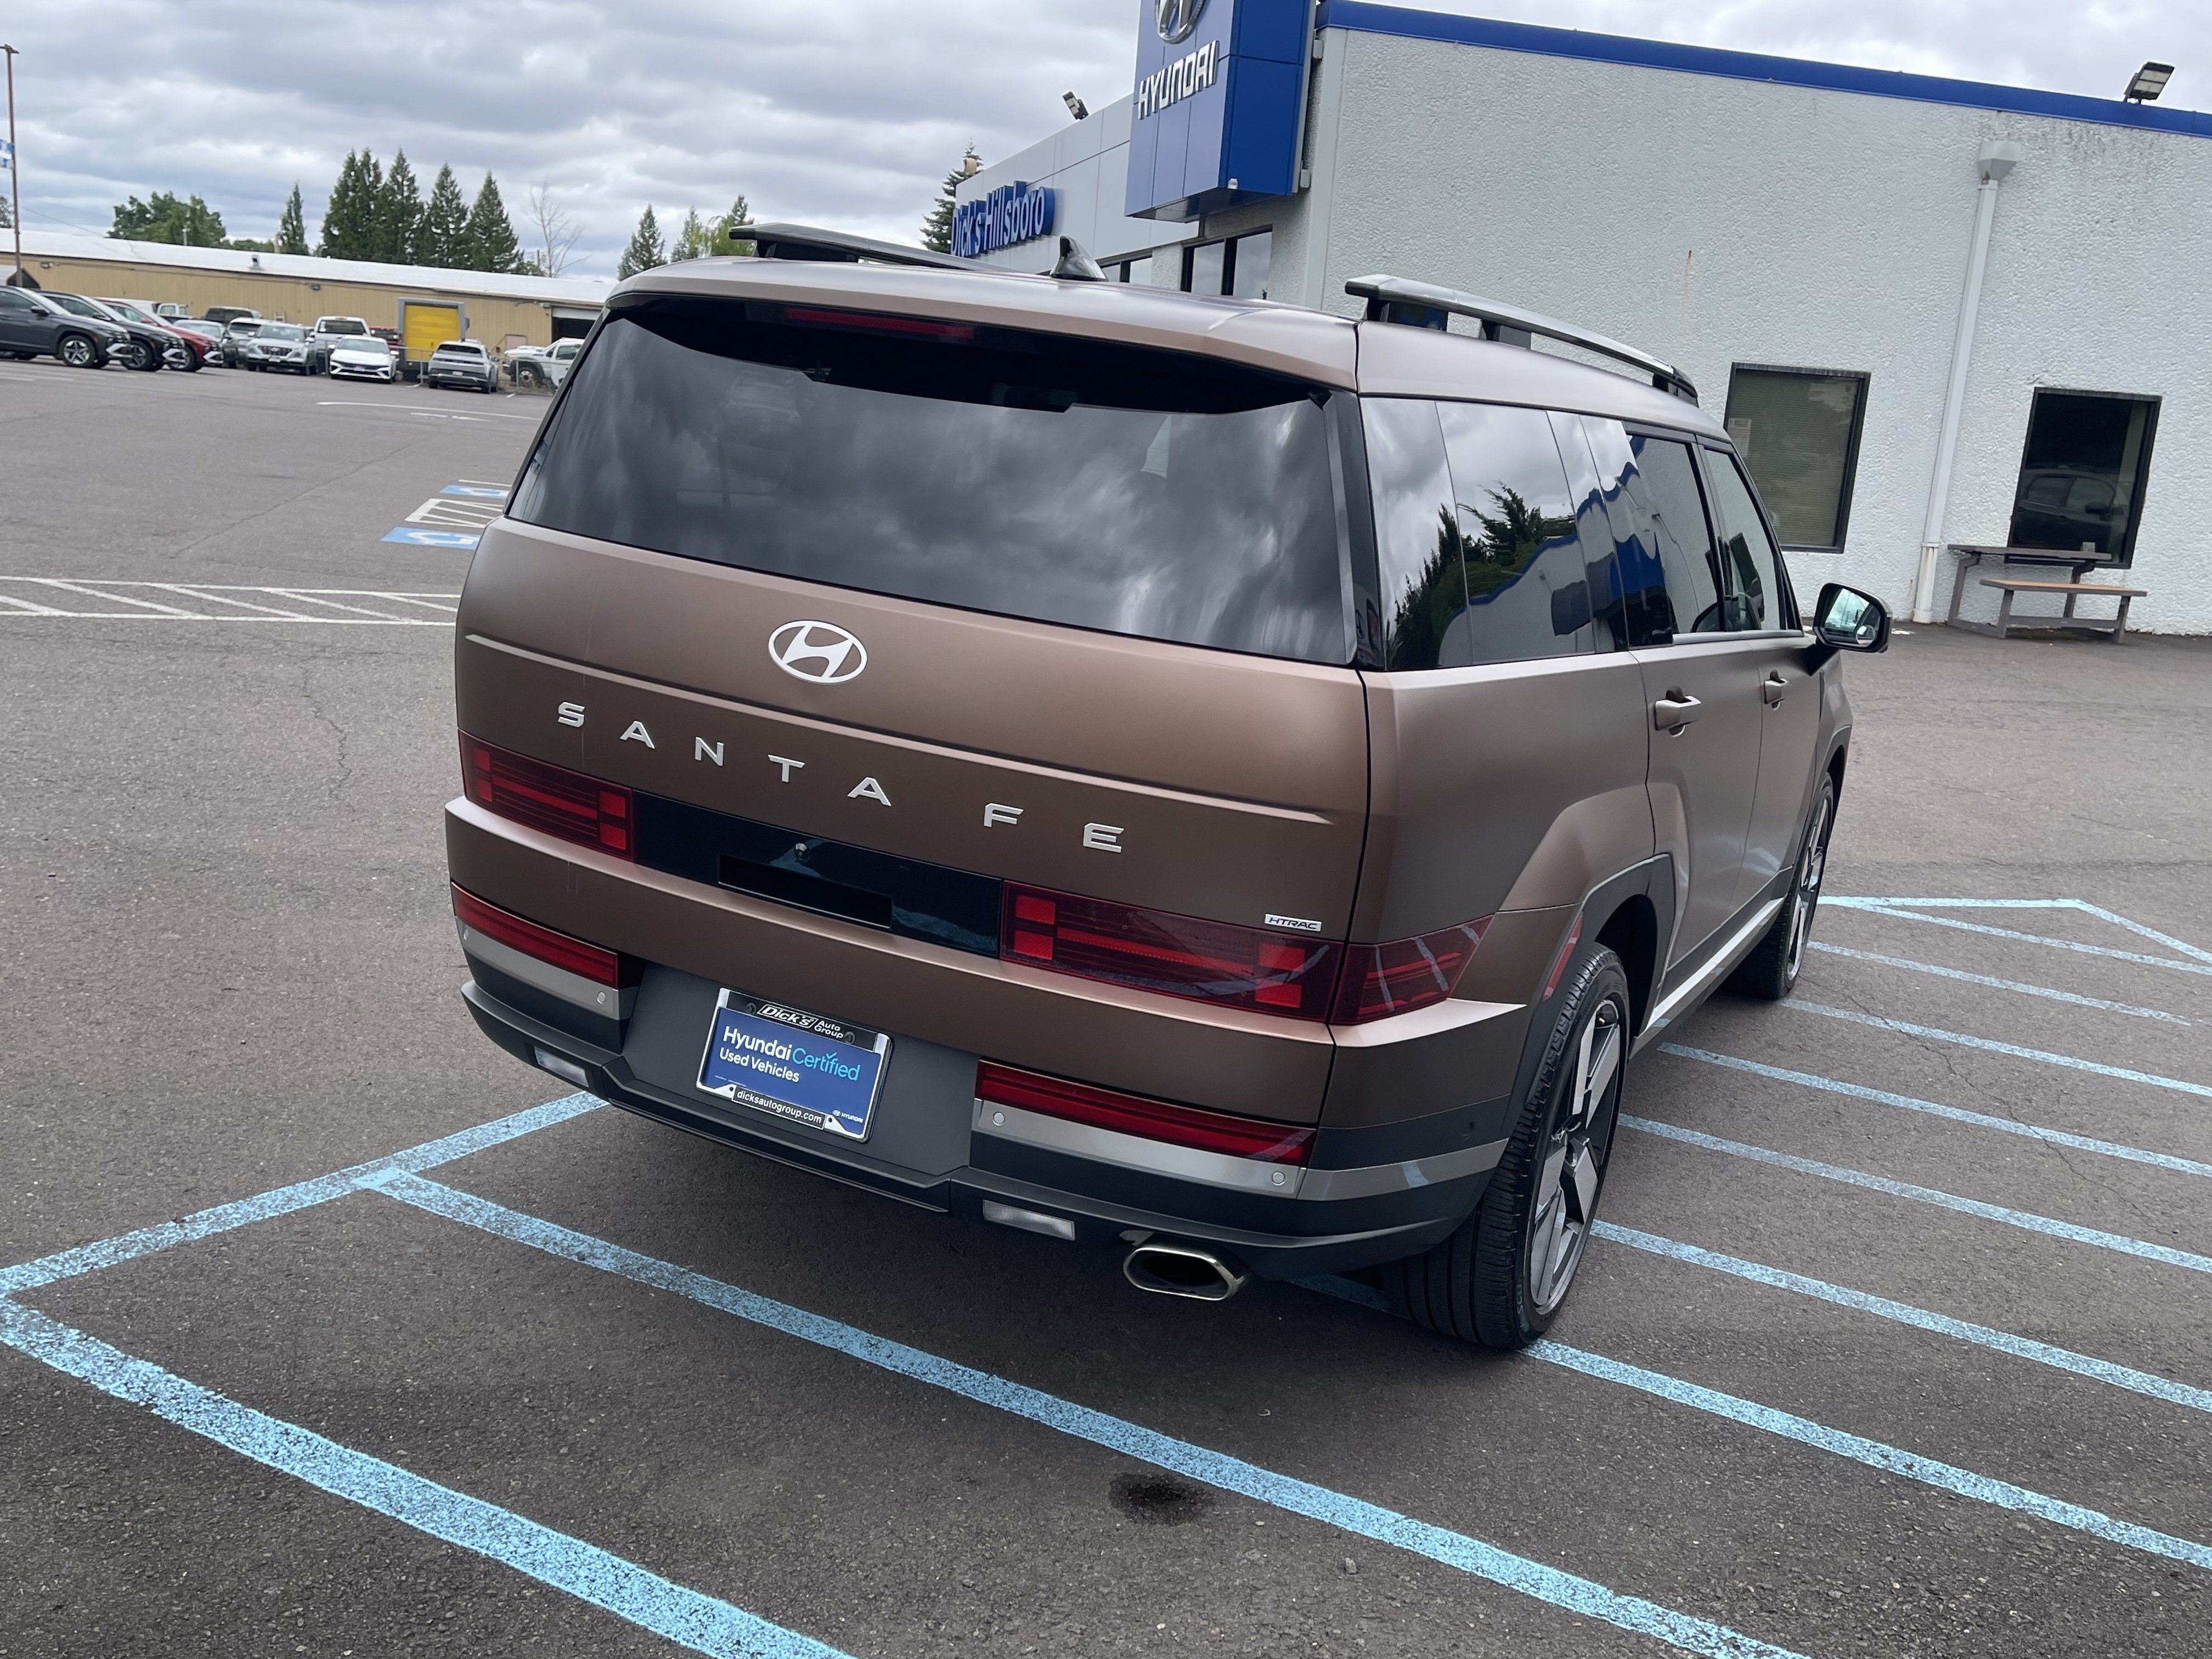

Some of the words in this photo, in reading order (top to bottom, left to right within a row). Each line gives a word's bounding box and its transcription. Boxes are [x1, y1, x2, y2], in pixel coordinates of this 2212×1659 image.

[1138, 40, 1220, 120] HYUNDAI
[951, 206, 984, 257] Dick's
[984, 182, 1049, 251] Hillsboro
[558, 702, 891, 806] SANTA
[984, 803, 1124, 853] FE
[1268, 916, 1318, 930] HTRAC
[761, 1006, 811, 1026] Dick's
[814, 1025, 844, 1039] Group
[817, 1020, 841, 1031] Auto
[719, 1047, 750, 1067] Used
[751, 1056, 800, 1082] Vehicles
[723, 1026, 793, 1061] Hyundai
[792, 1047, 861, 1081] Certified
[737, 1091, 822, 1124] dicksautogroup.com
[841, 1112, 864, 1124] HYUNDAI
